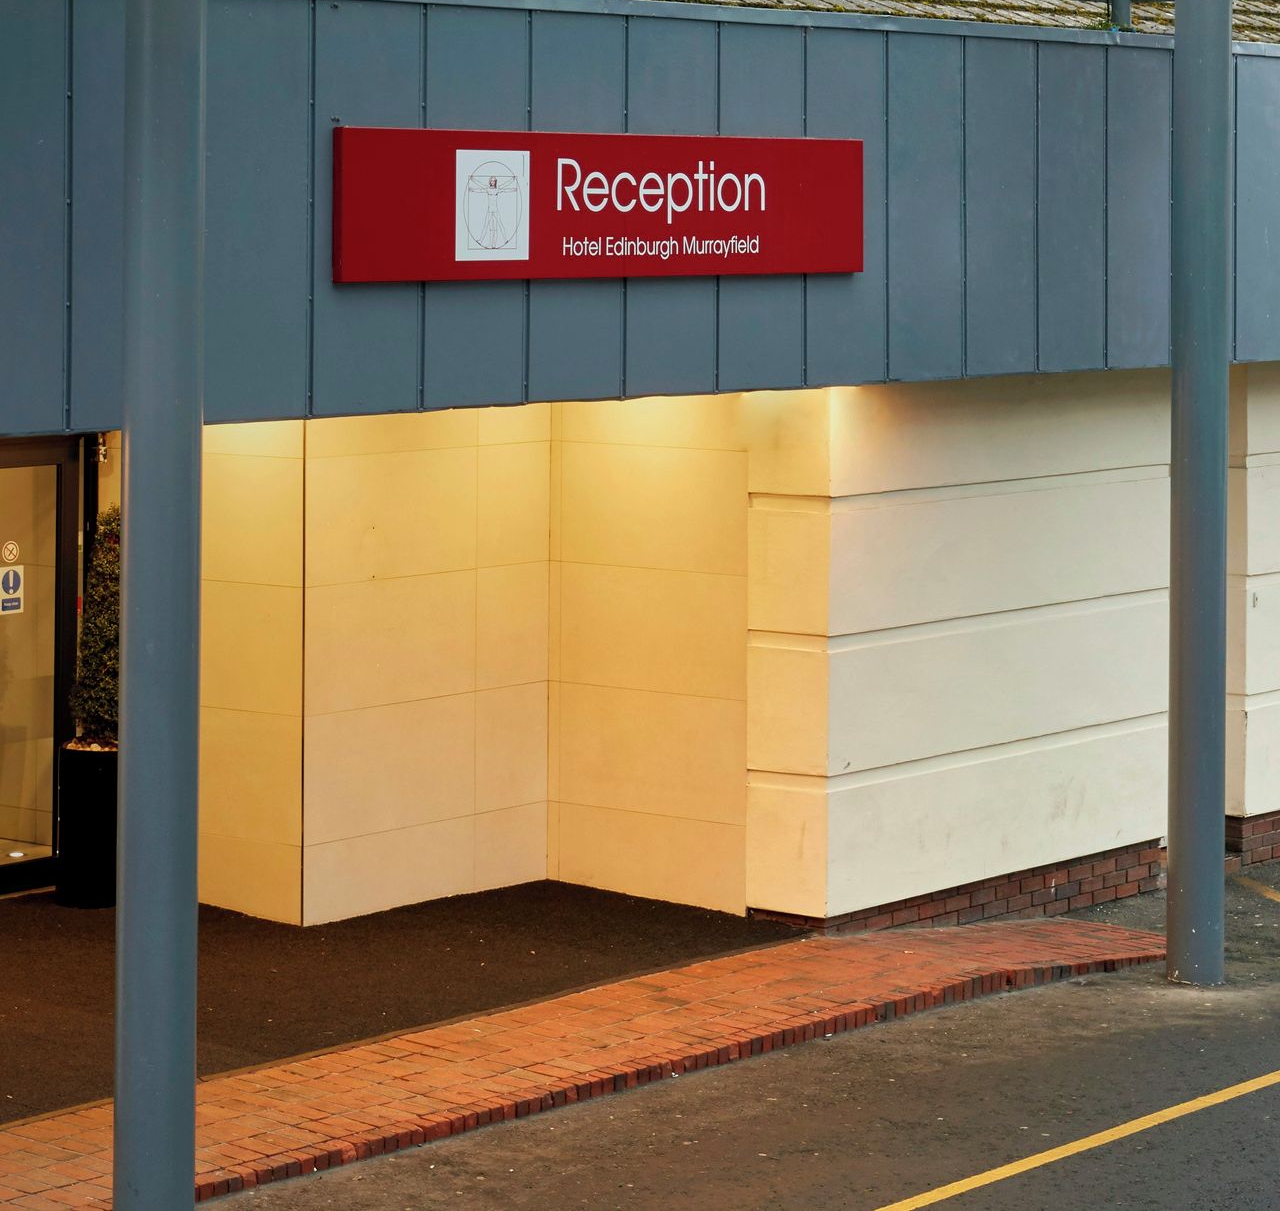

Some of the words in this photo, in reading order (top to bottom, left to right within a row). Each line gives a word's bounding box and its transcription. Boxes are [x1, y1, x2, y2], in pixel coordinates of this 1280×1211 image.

[556, 157, 766, 225] Reception
[562, 236, 602, 256] Hotel
[605, 235, 679, 260] Edinburgh
[682, 235, 760, 260] Murrayfield
